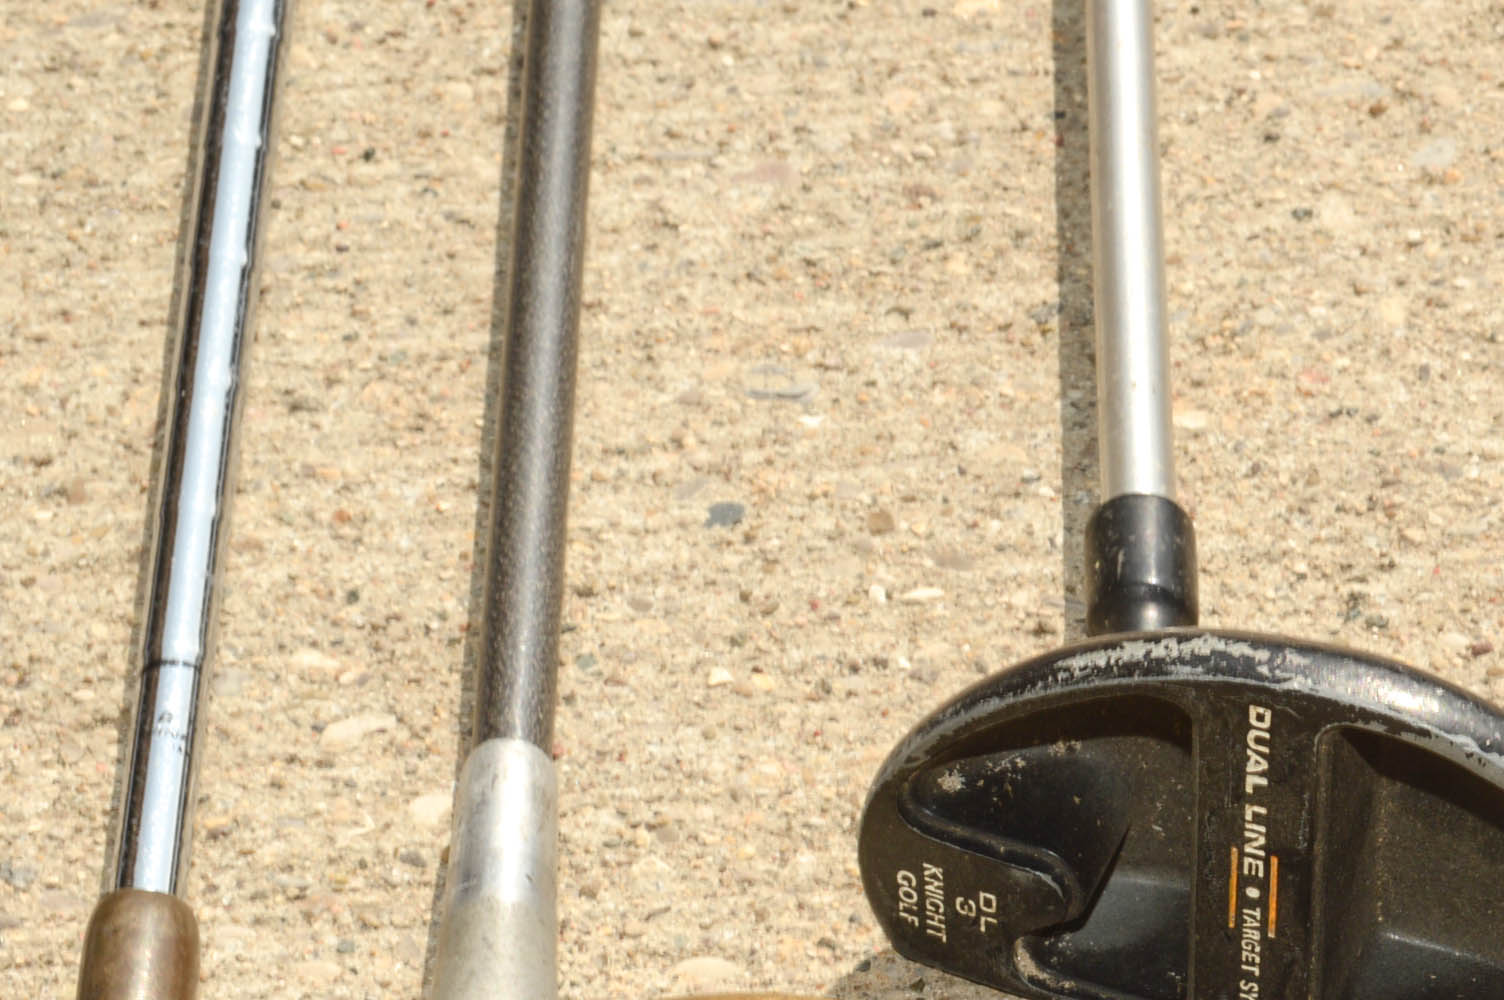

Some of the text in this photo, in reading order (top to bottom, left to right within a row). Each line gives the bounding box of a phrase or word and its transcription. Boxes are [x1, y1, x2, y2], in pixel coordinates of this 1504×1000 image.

[1244, 704, 1273, 795] DUAL
[1243, 803, 1268, 879] LINE
[897, 870, 920, 927] GOLF
[922, 862, 947, 943] KNIGHT
[956, 897, 976, 918] 3
[980, 891, 998, 933] DL
[1241, 906, 1262, 979] TARGET
